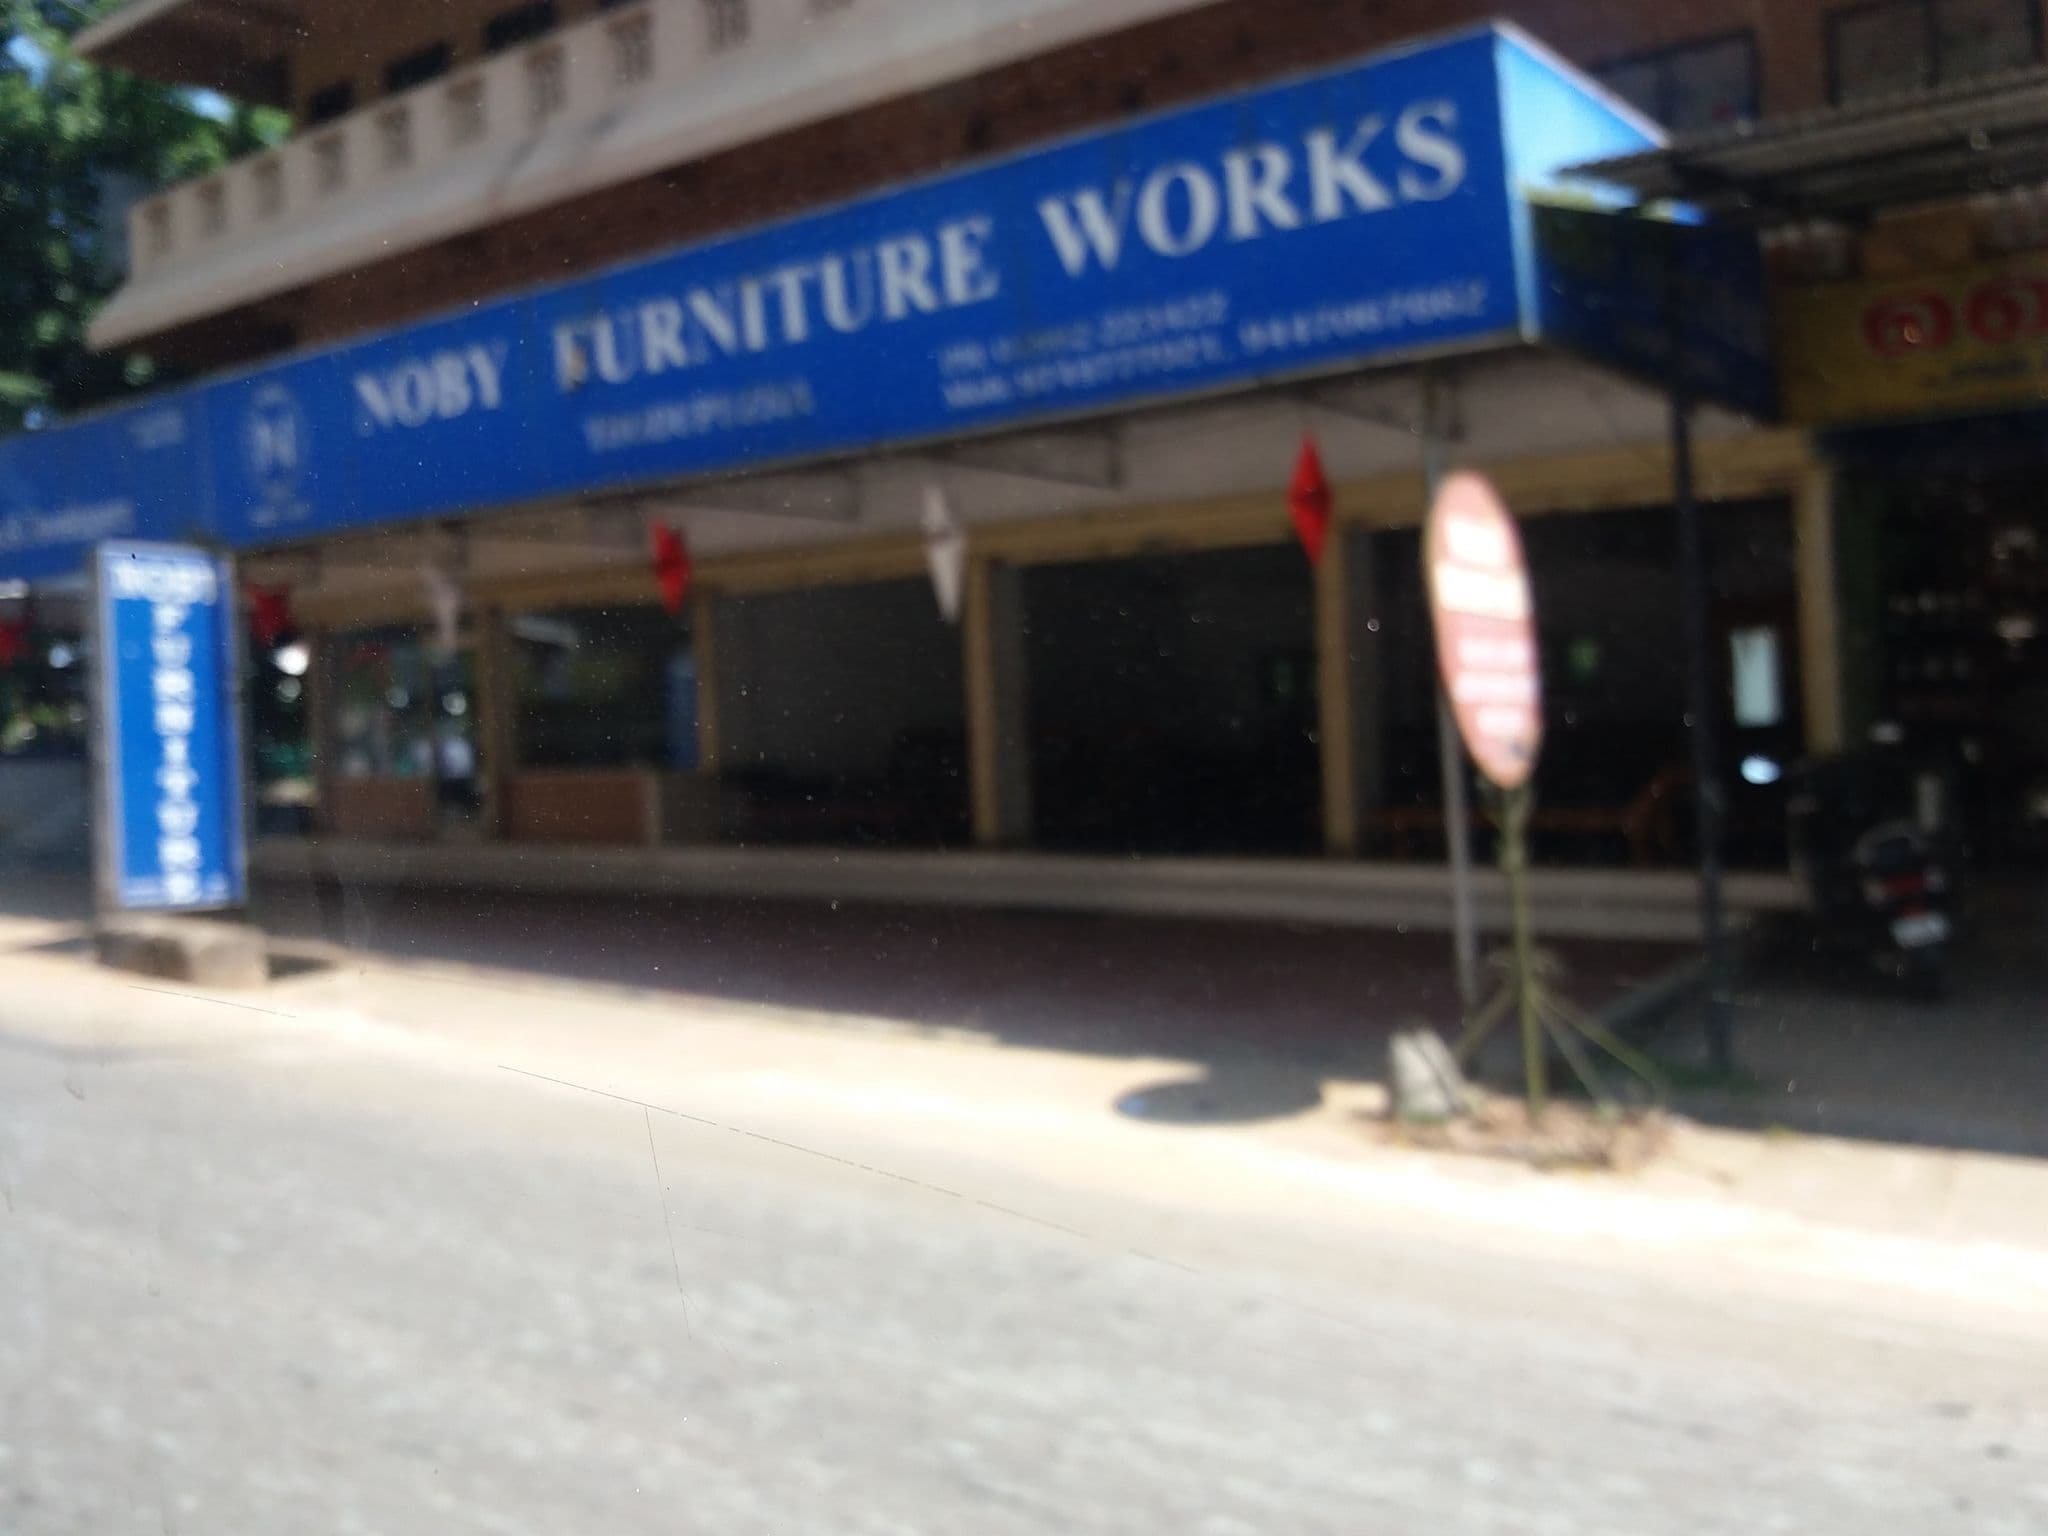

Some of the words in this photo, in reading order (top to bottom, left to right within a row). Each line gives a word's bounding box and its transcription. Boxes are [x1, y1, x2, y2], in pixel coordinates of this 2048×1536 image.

[355, 339, 507, 437] NOBY
[552, 215, 999, 392] FURNITURE
[1038, 99, 1466, 278] WORKS
